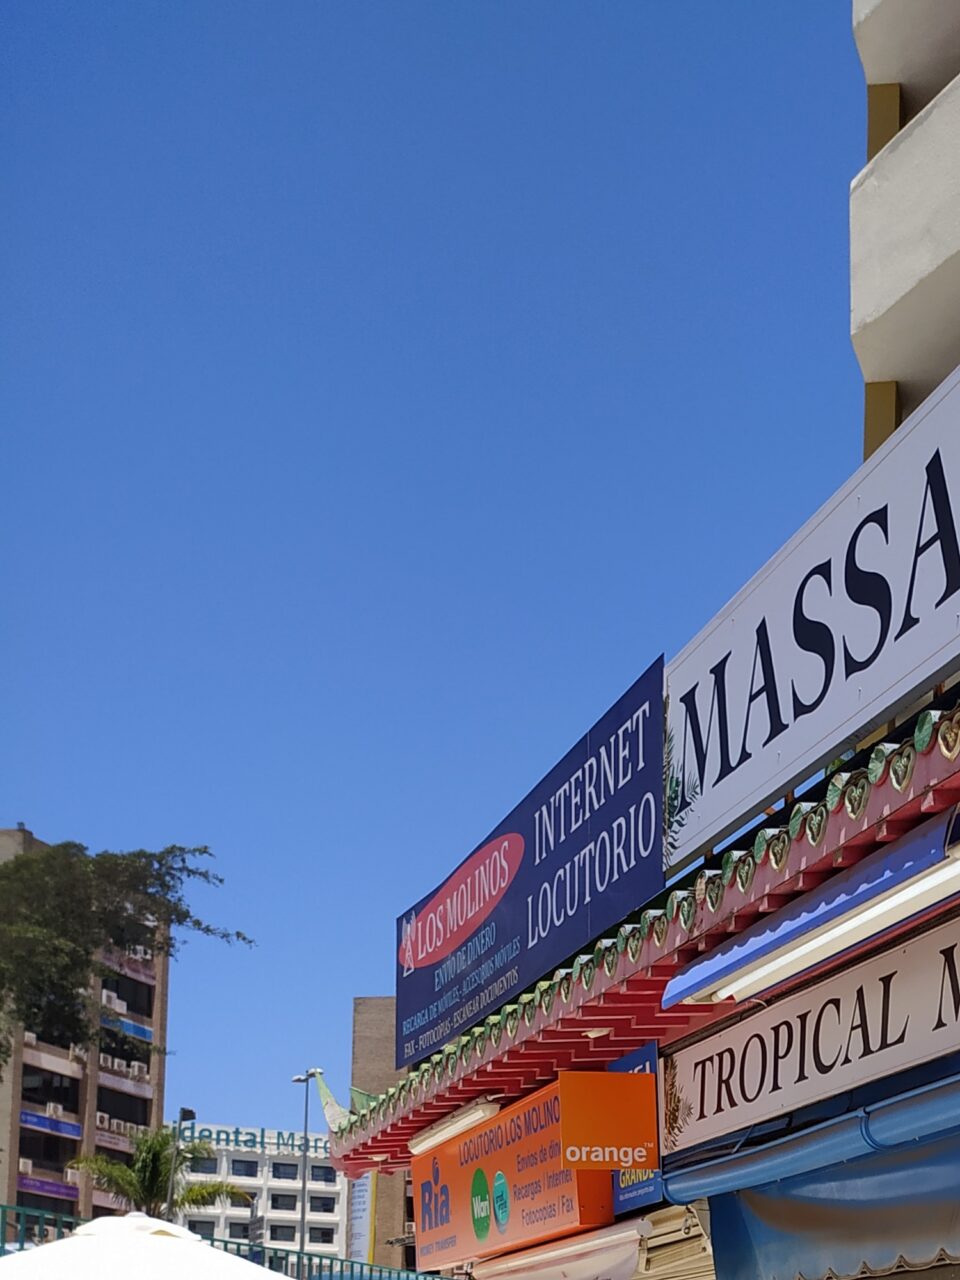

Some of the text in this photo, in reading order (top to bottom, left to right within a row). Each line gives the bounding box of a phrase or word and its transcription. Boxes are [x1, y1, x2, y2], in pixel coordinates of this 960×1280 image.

[533, 701, 650, 866] INTERNET
[526, 792, 657, 949] LOCUTORIO
[417, 841, 510, 961] LOS MOLINOS
[456, 951, 466, 975] DE
[404, 1041, 415, 1058] FAX
[694, 971, 910, 1122] TROPICAL
[459, 1126, 503, 1168] LOCUTORIO
[505, 1116, 523, 1146] LOS
[565, 1145, 648, 1167] orange
[420, 1158, 450, 1232] Ria
[513, 1168, 573, 1201] Recargas Internet
[562, 1194, 574, 1216] Fax
